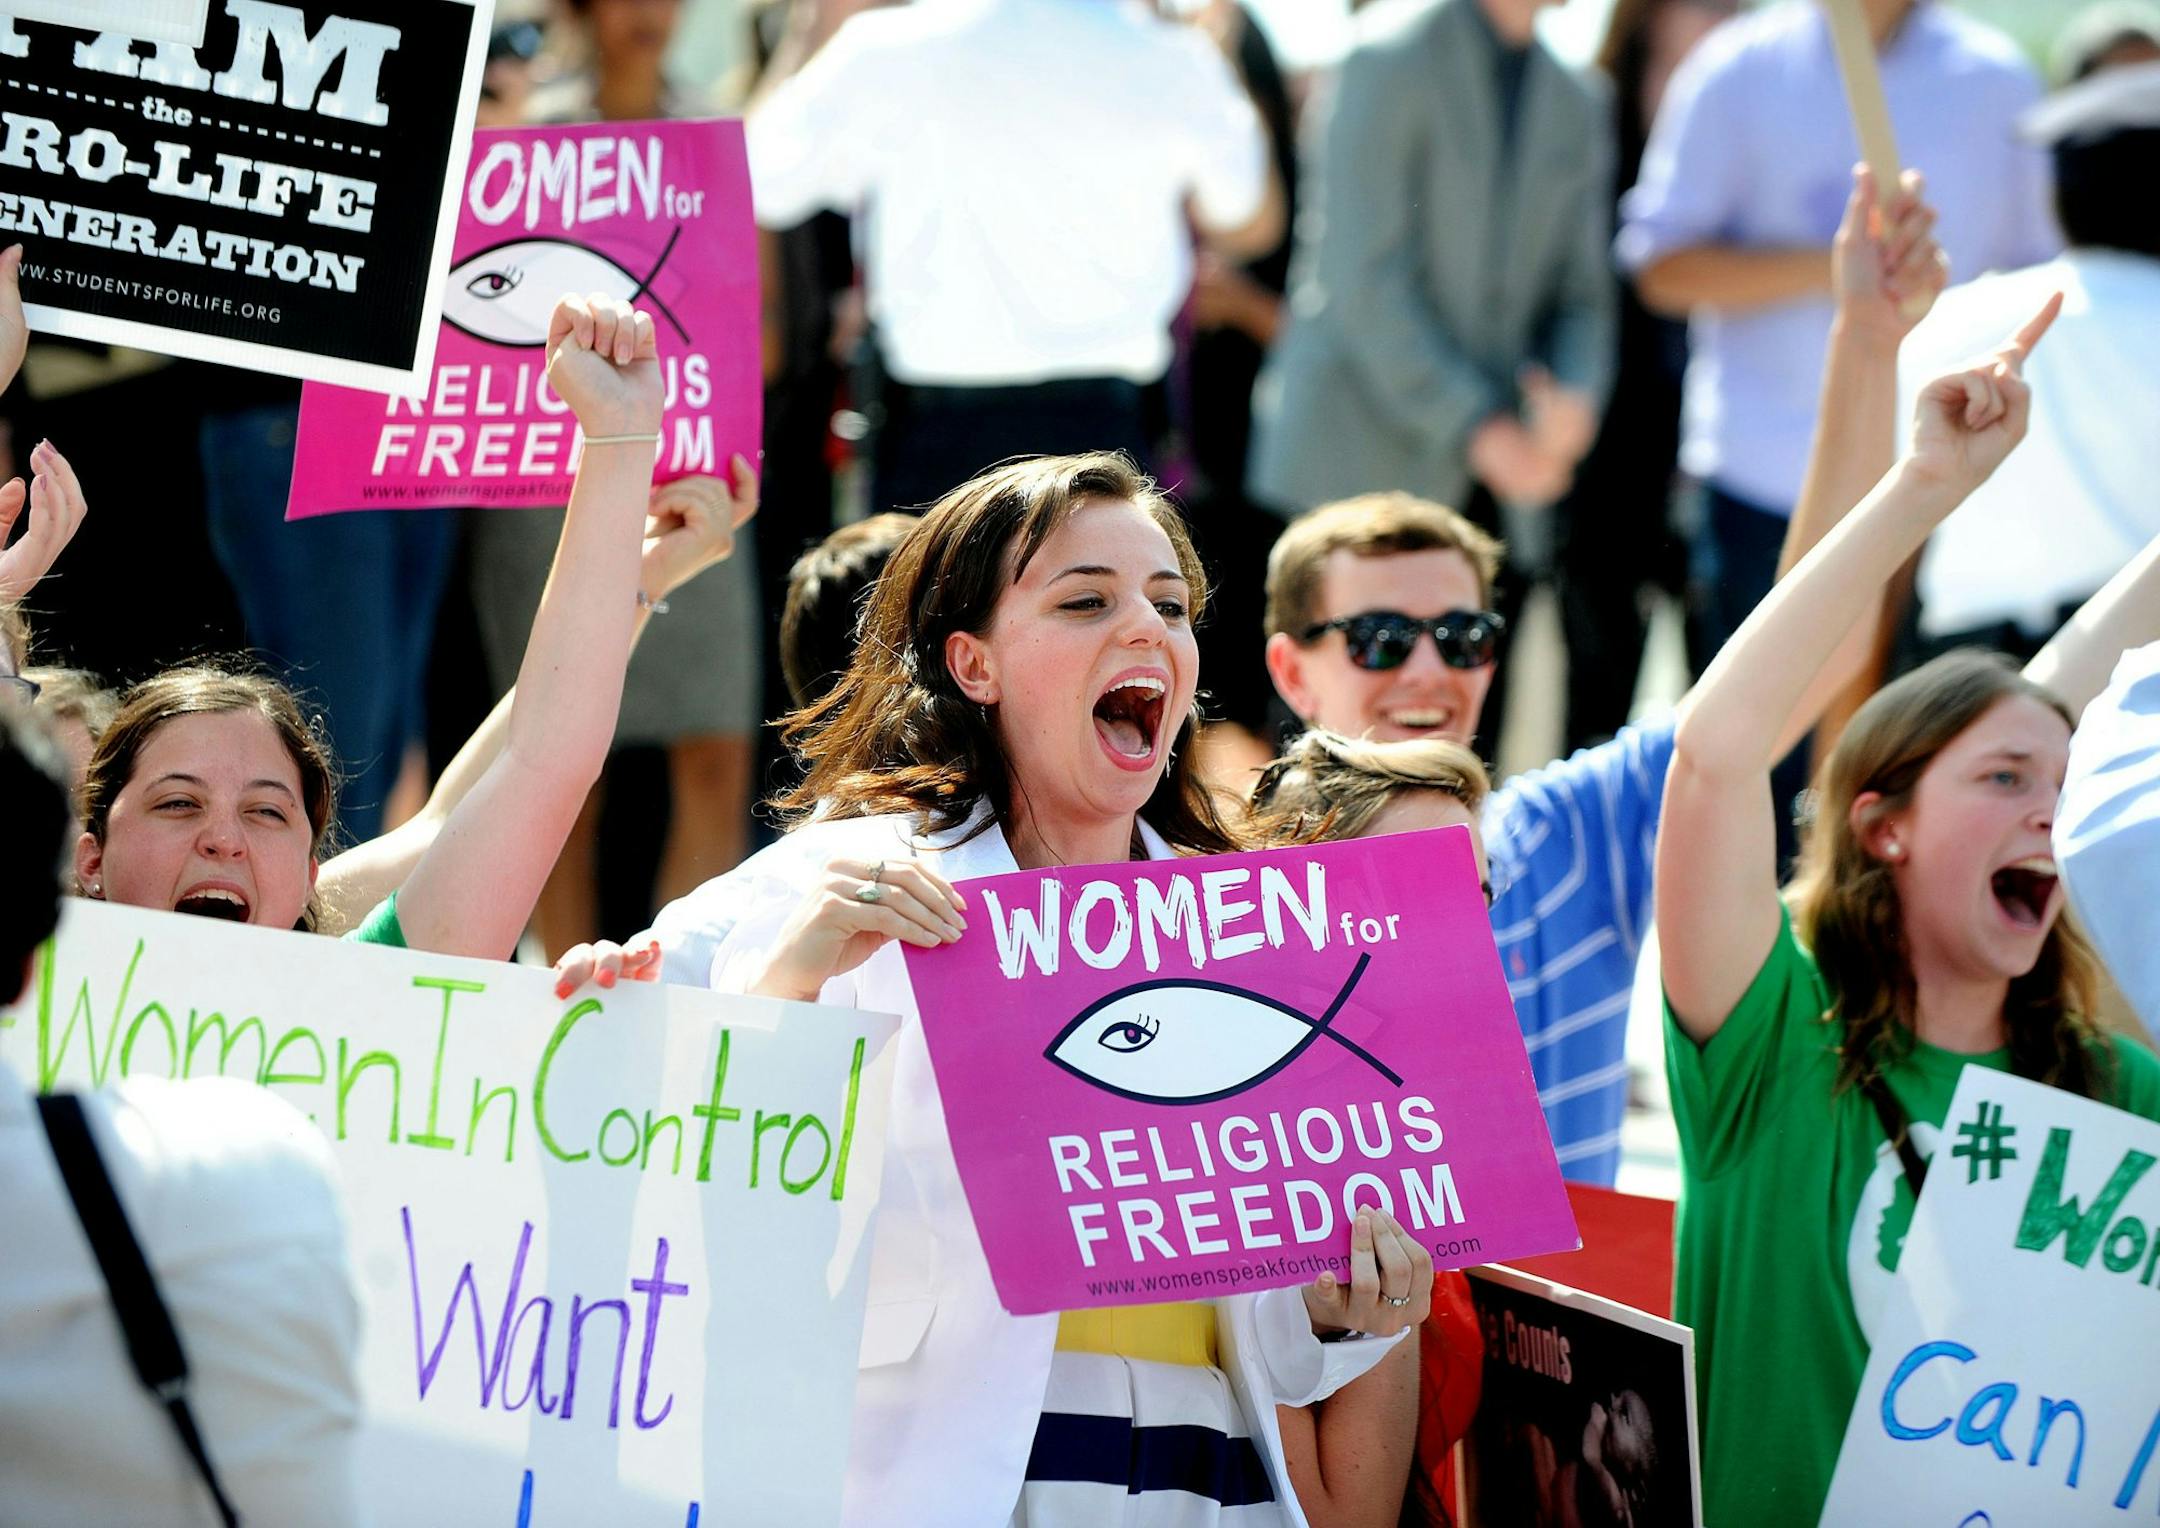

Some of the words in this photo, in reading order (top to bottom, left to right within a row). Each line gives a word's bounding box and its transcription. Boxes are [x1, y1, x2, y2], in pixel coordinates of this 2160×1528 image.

[141, 96, 193, 127] the
[0, 111, 377, 233] RO-LIFE
[469, 136, 662, 231] OMEN
[664, 187, 704, 219] for
[0, 192, 365, 293] NERATION
[18, 261, 281, 324] WW.STUDENTSFORLIFE.ORG
[371, 416, 715, 477] FREEM
[982, 861, 1333, 980] WOMEN
[1340, 910, 1401, 947] for
[1048, 1096, 1444, 1194] RELIGIOUS
[1068, 1163, 1466, 1267] FREEDOM
[401, 1206, 690, 1430] Want
[1503, 1309, 1572, 1385] Counts
[1881, 1340, 2086, 1489] Can
